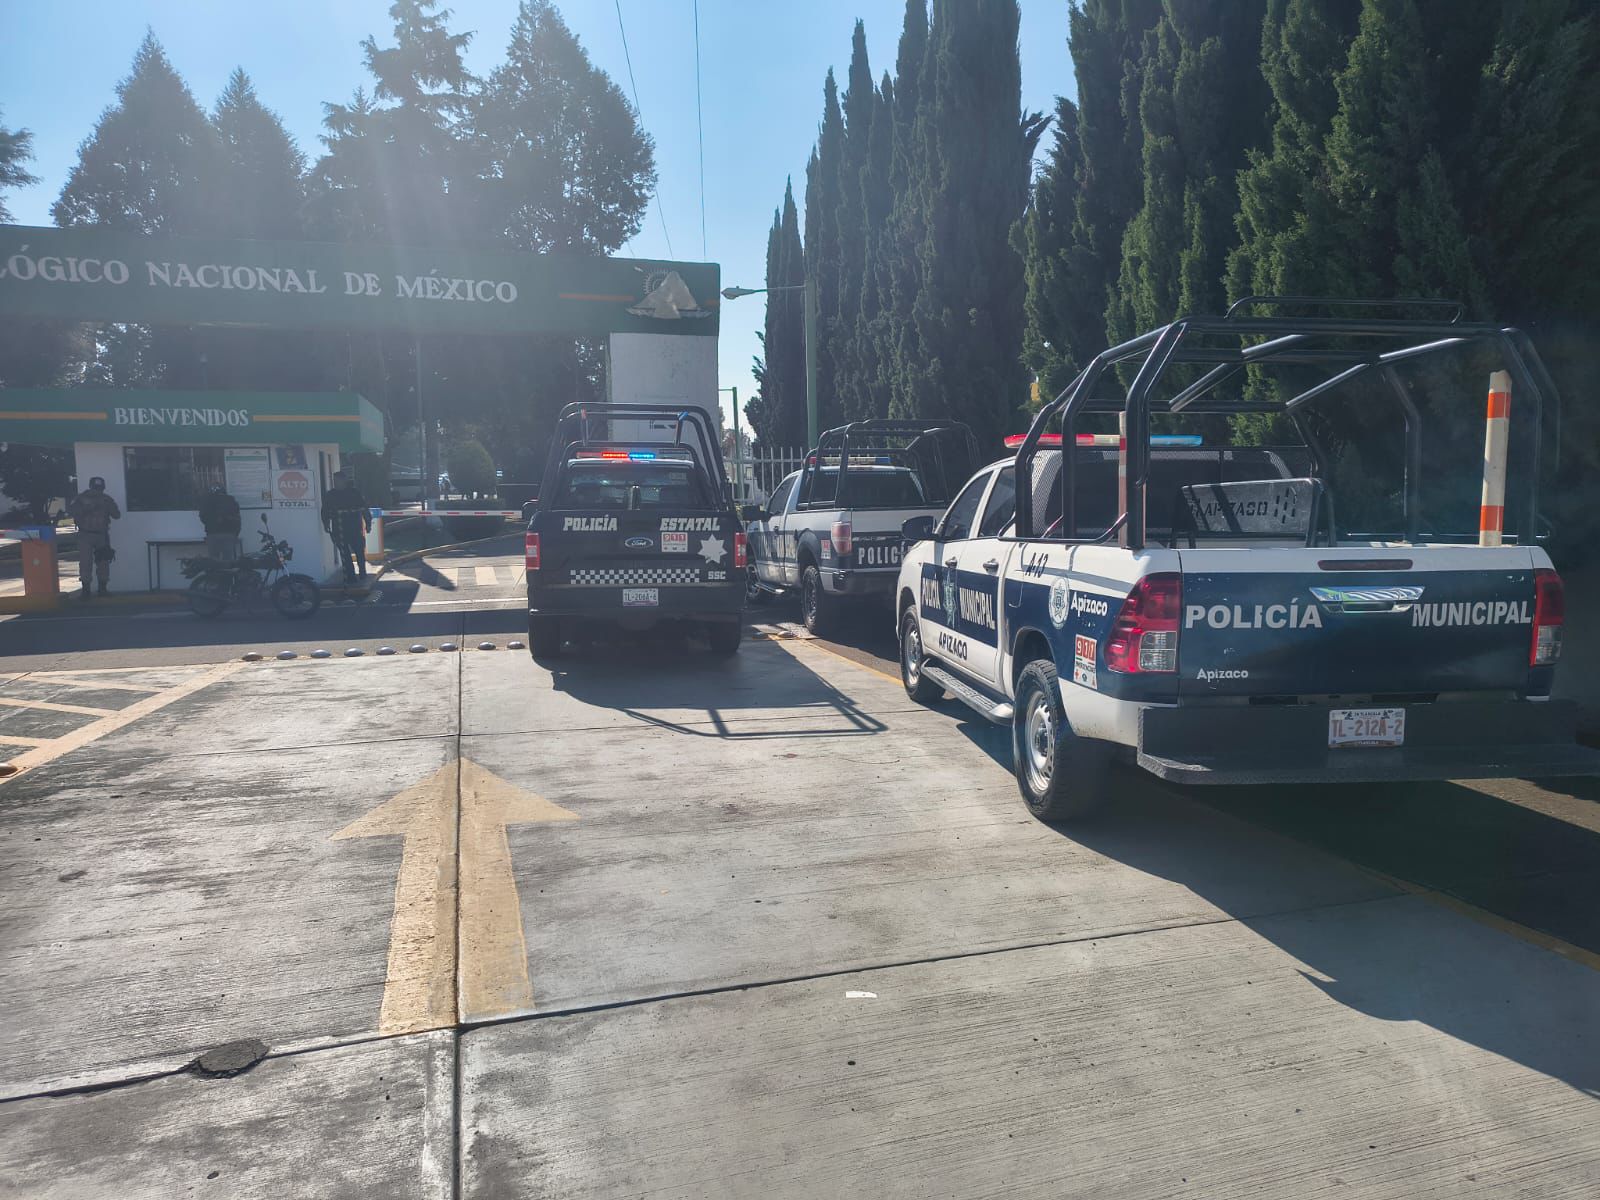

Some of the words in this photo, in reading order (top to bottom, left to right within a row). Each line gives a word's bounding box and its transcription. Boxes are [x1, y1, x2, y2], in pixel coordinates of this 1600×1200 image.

[0, 244, 130, 285] ÓGICO
[145, 261, 328, 294] NACIONAL
[343, 271, 382, 297] DE
[395, 268, 518, 303] MÉXICO
[114, 407, 249, 427] BIENVENIDOS
[280, 480, 308, 489] ALTO
[563, 514, 618, 531] POLICÍA
[659, 517, 720, 531] ESTATAL
[708, 570, 726, 580] SSC
[959, 587, 996, 630] MUNICIPAL
[1070, 591, 1108, 617] Apizaco
[1184, 597, 1323, 629] POLICÍA
[1412, 600, 1532, 627] MUNICIPAL
[938, 631, 968, 661] APIZACO
[1077, 639, 1095, 659] 911
[1196, 667, 1249, 683] Apizaco
